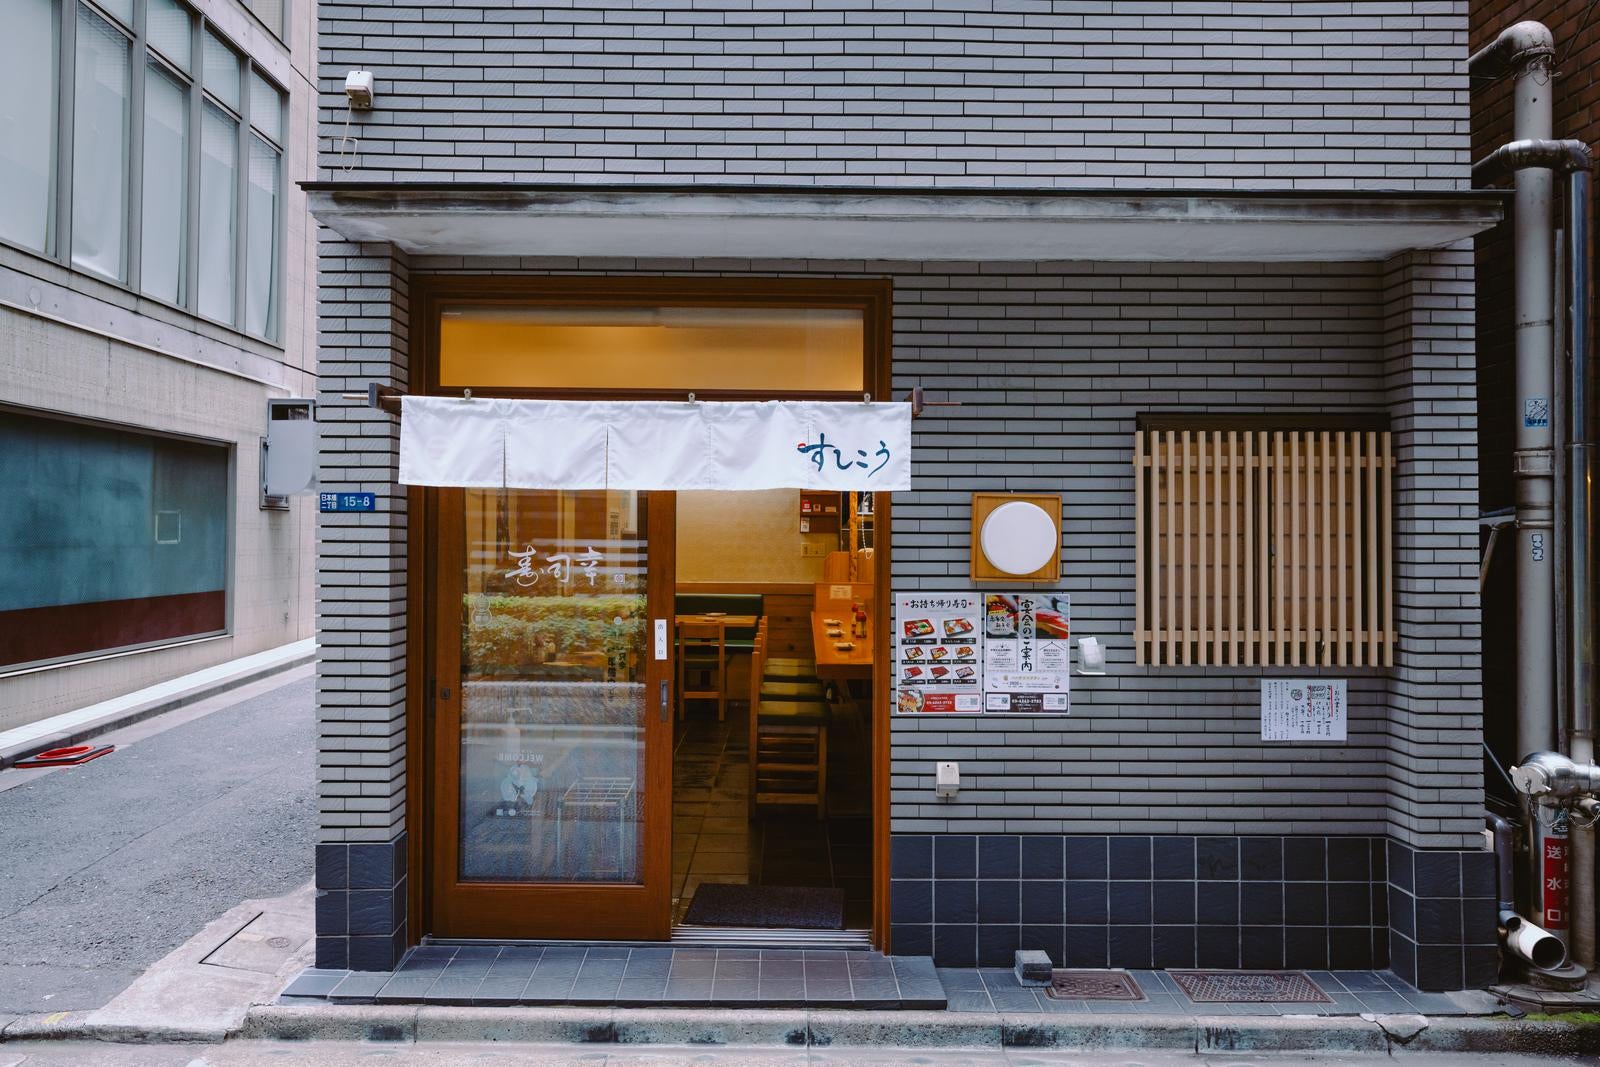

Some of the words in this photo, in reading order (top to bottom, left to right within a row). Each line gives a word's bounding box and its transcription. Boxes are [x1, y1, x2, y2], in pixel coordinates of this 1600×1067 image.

[797, 432, 890, 478] すしこう
[321, 501, 337, 509] 二丁目
[344, 496, 370, 507] 15-8
[910, 599, 968, 609] お持ち帰り寿司
[1020, 599, 1034, 672] 宴会のご案内
[1546, 845, 1562, 921] 送水口
